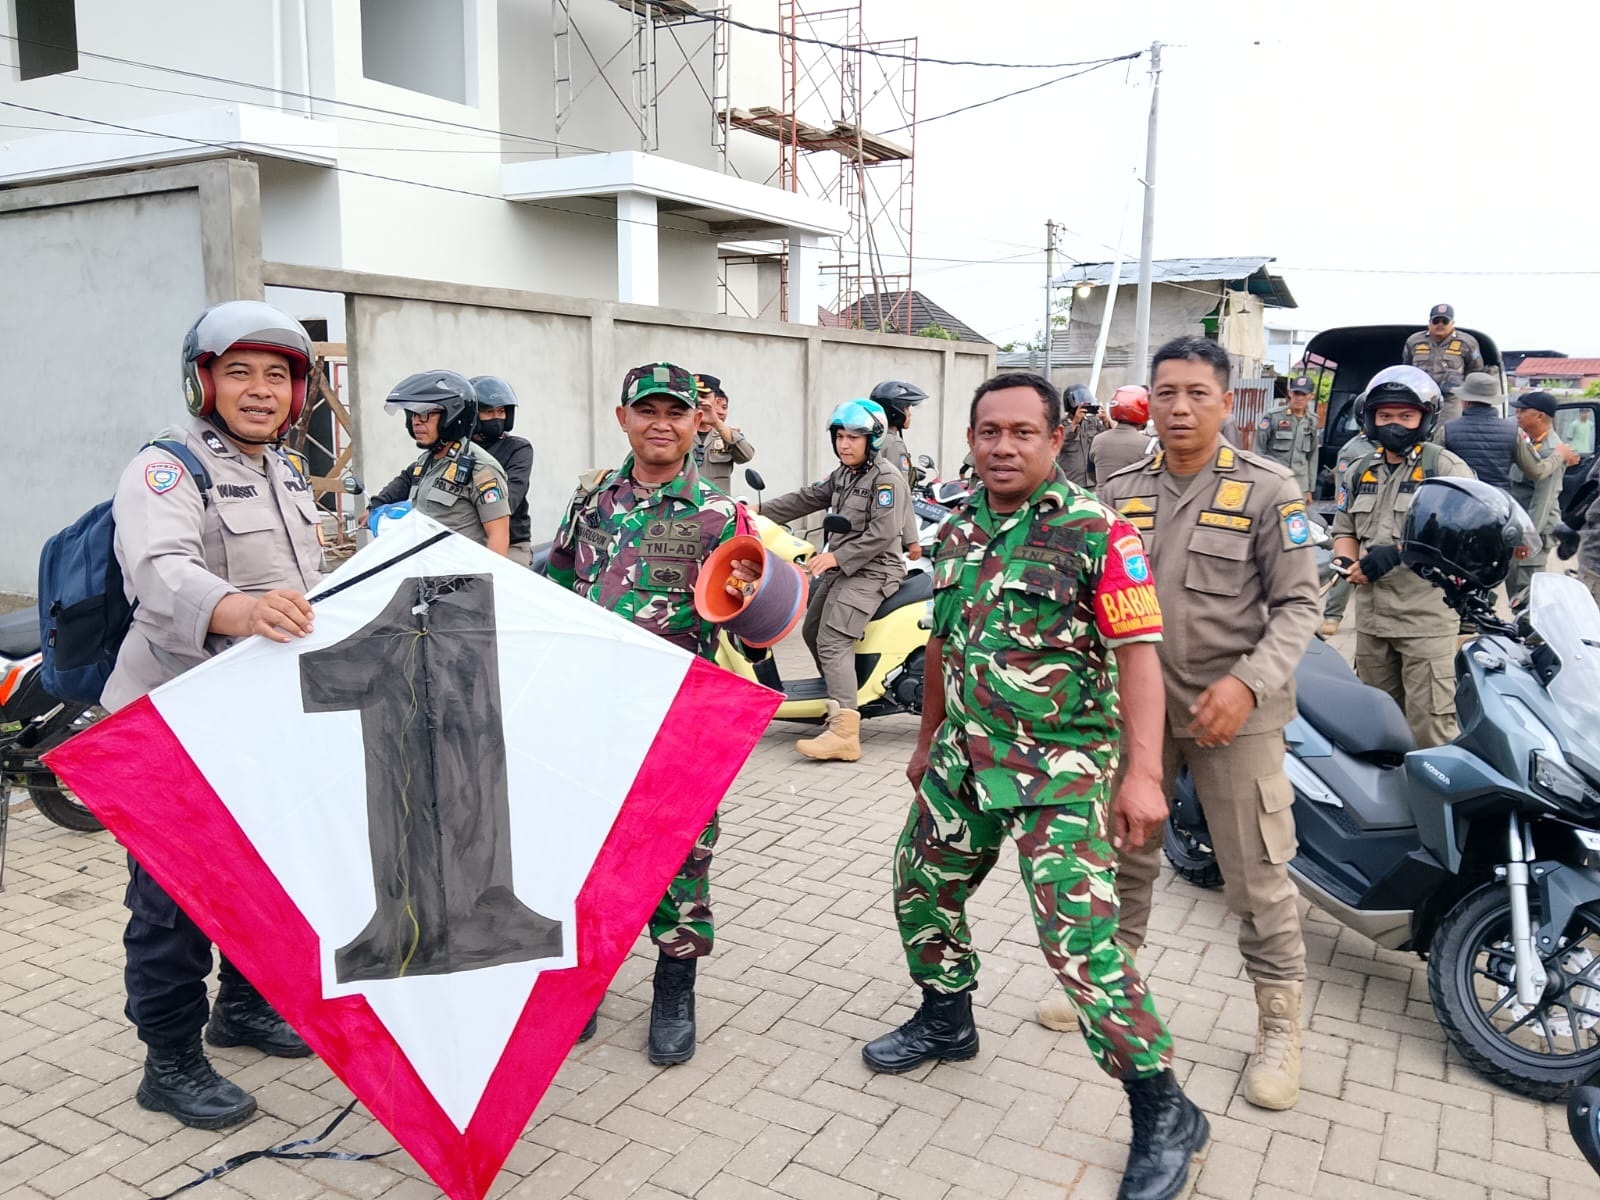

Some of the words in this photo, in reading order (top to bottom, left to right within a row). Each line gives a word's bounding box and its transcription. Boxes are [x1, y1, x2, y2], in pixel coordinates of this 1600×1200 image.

[646, 542, 696, 556] TNI-AD
[298, 573, 563, 984] 1
[1423, 761, 1451, 785] HONDA
